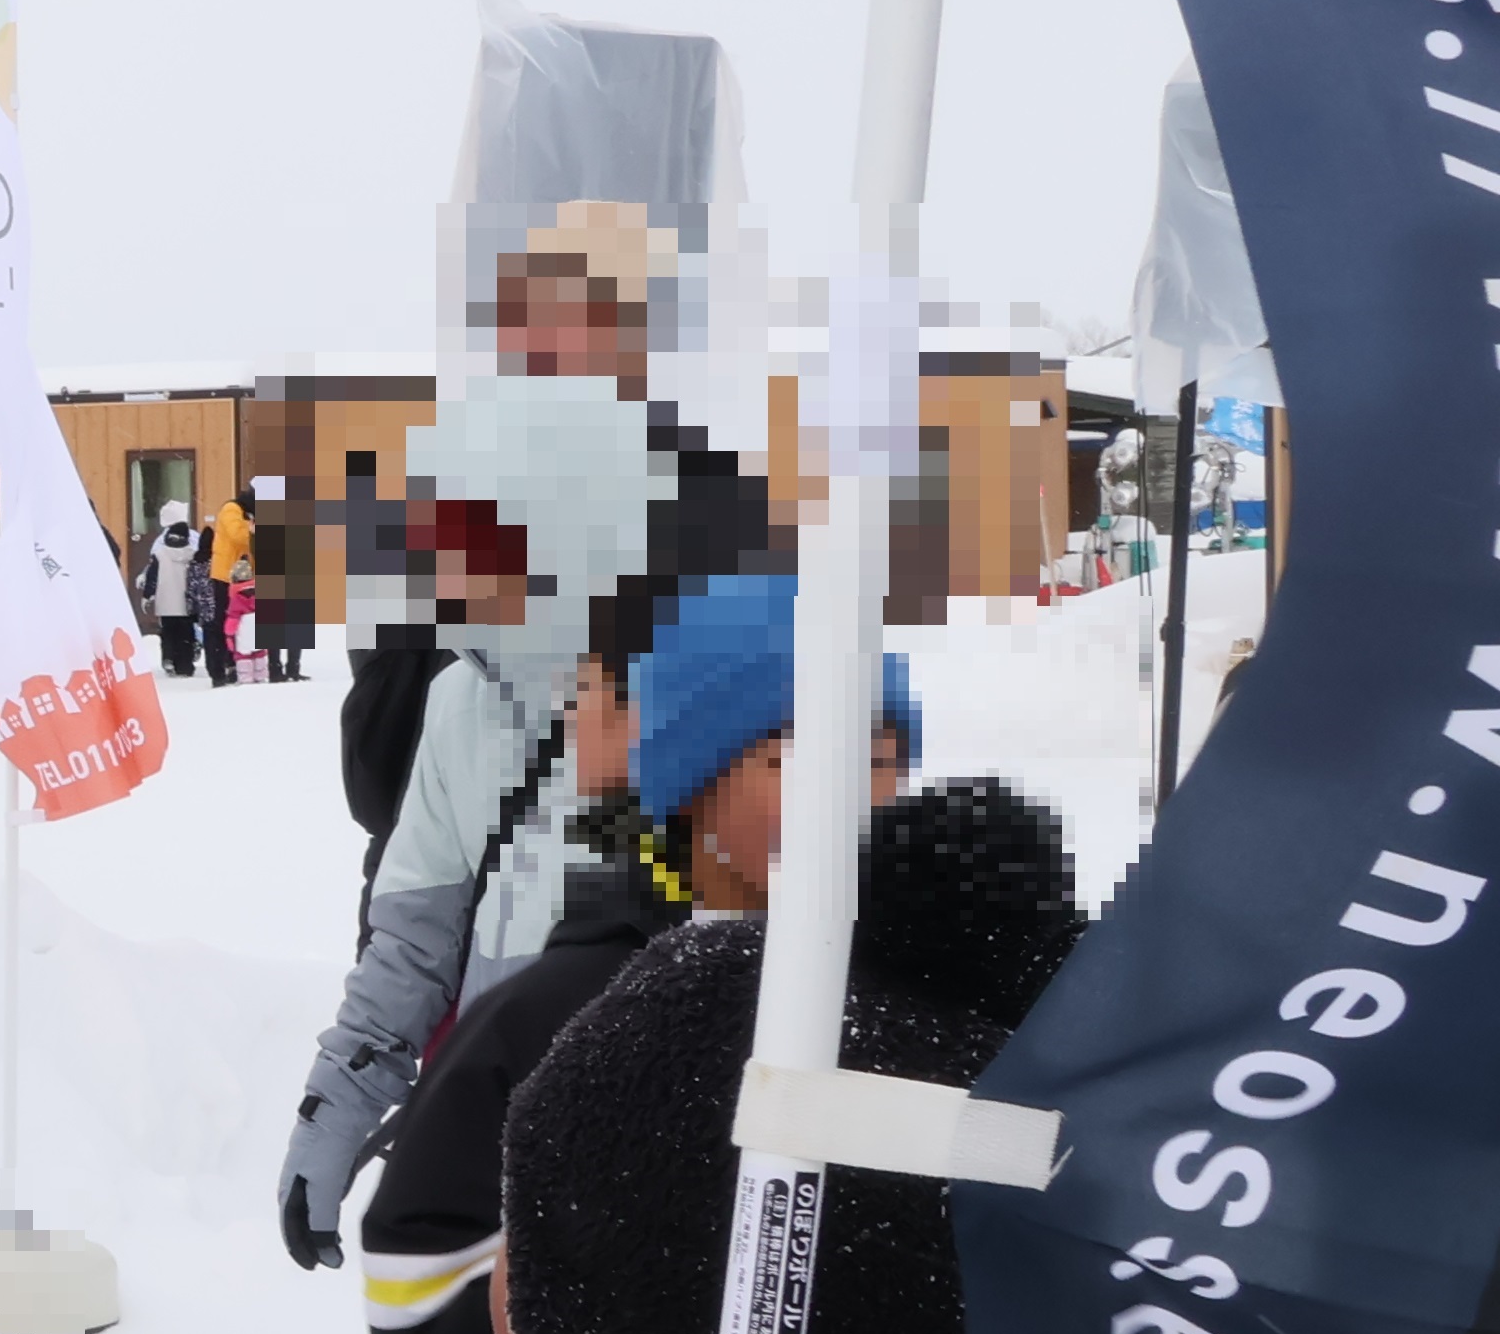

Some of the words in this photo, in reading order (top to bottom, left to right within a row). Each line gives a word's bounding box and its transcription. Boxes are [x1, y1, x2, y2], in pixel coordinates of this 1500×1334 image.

[781, 1182, 819, 1330] のぼりポール
